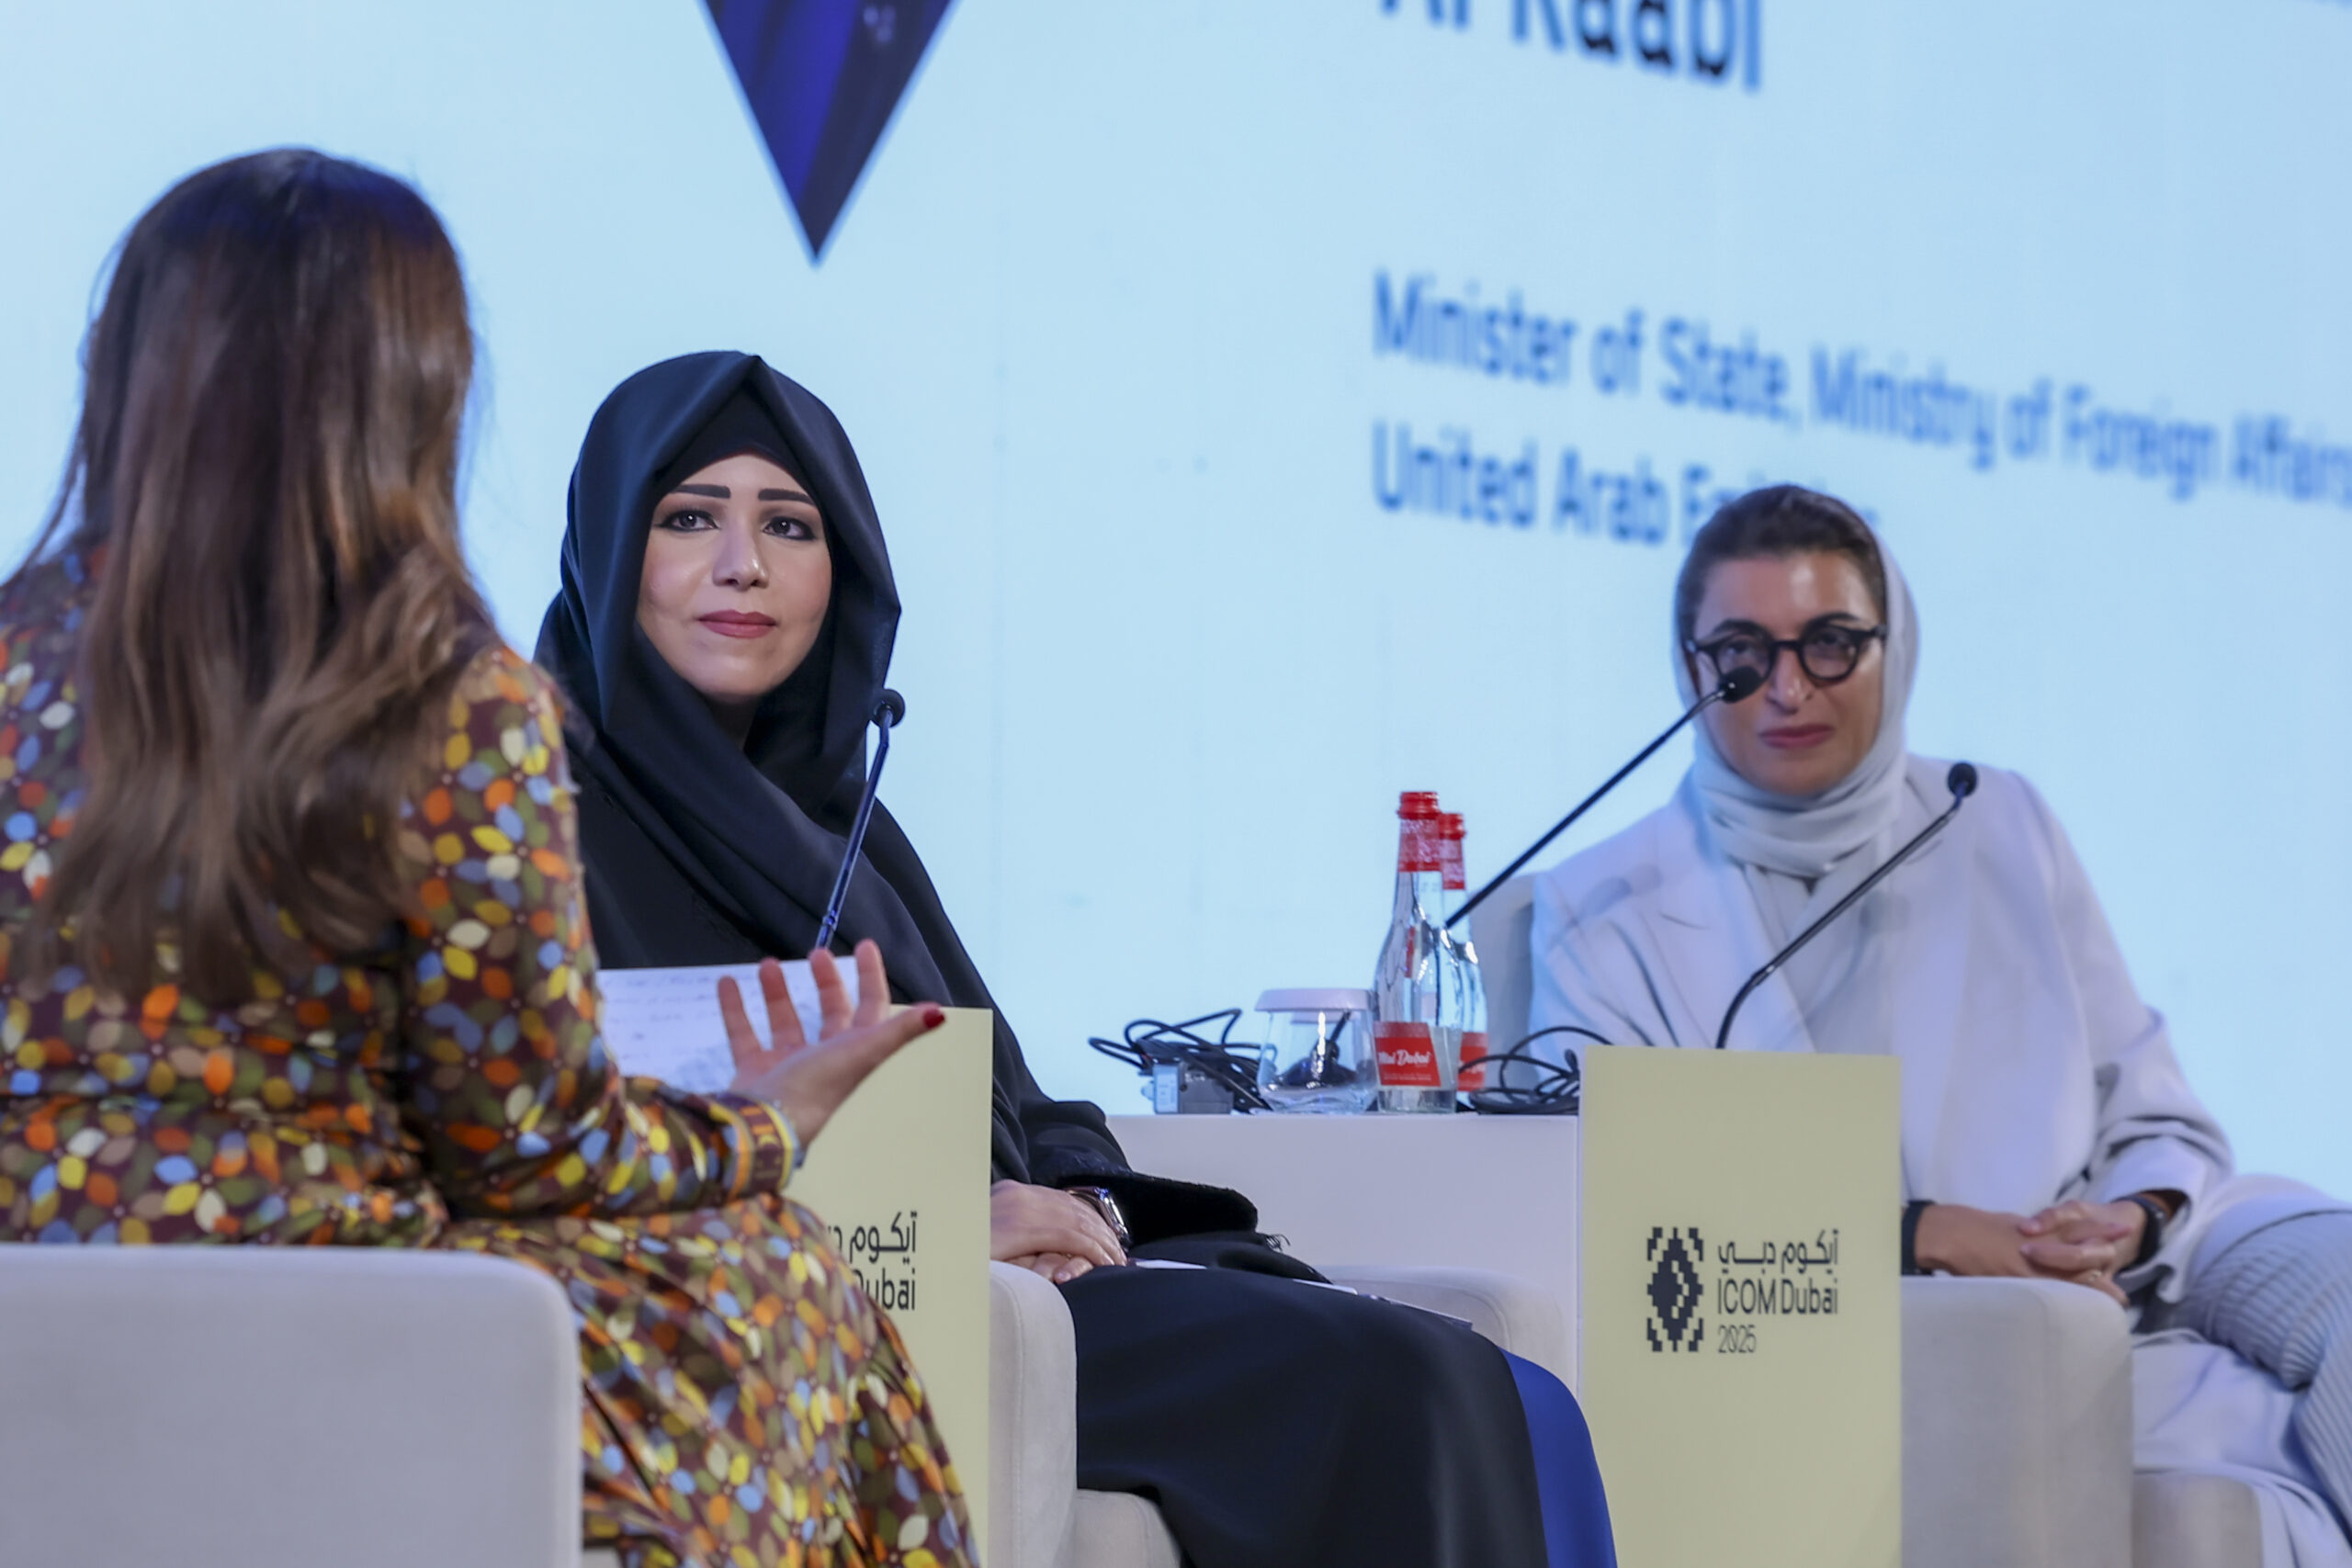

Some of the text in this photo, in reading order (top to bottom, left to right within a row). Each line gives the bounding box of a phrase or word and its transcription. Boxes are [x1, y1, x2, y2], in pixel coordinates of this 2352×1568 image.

[1373, 269, 1576, 389] Minister
[1590, 307, 1645, 397] of
[1810, 341, 1997, 472] Ministry
[2006, 377, 2054, 460] of
[2062, 384, 2222, 502] Foreign
[1373, 421, 1538, 528] United
[1553, 446, 1672, 548] Arab
[1717, 1241, 1777, 1275] دبي
[1717, 1278, 1838, 1314] ICOM Dubai
[1717, 1325, 1757, 1354] 2025
